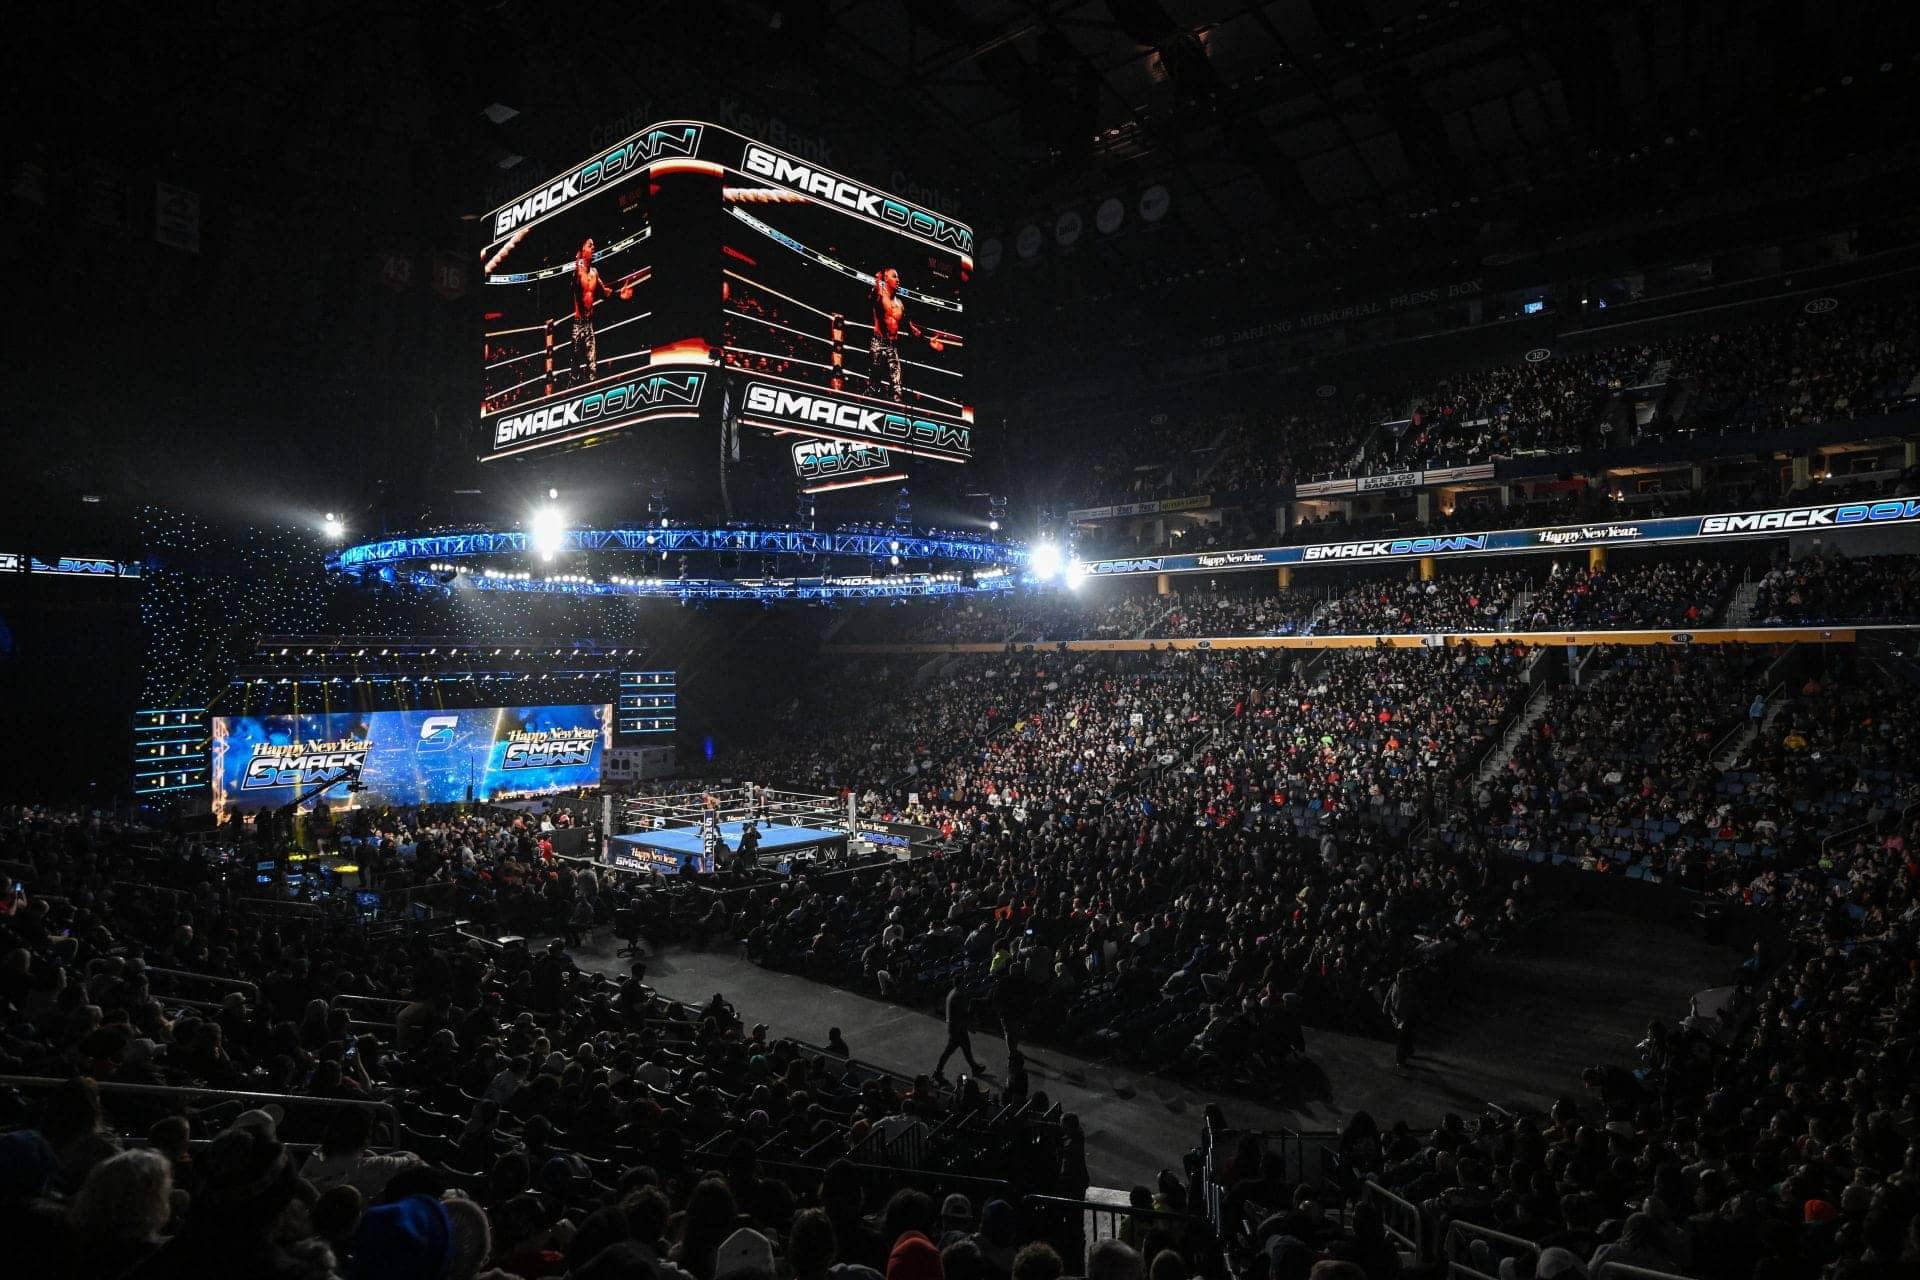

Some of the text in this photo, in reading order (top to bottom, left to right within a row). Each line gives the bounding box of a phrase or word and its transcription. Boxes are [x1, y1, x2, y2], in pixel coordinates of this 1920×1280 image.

[719, 97, 832, 164] KeyBank
[496, 128, 696, 236] SMACKDOWN
[1232, 319, 1292, 343] DARLING
[1299, 301, 1381, 329] MEMORIAL
[1389, 288, 1440, 309] PRESS
[1448, 277, 1484, 298] BOX
[497, 376, 699, 442] SMACKDOWN
[749, 386, 971, 451] SMACKDOW
[1305, 535, 1485, 560] SMACKDOWN
[1538, 531, 1581, 544] Happy
[1580, 527, 1608, 539] New
[508, 730, 549, 743] Happy
[549, 727, 574, 739] New
[251, 742, 306, 758] Happy
[306, 738, 338, 753] New
[507, 740, 592, 759] SMACK
[249, 753, 363, 776] SMACK
